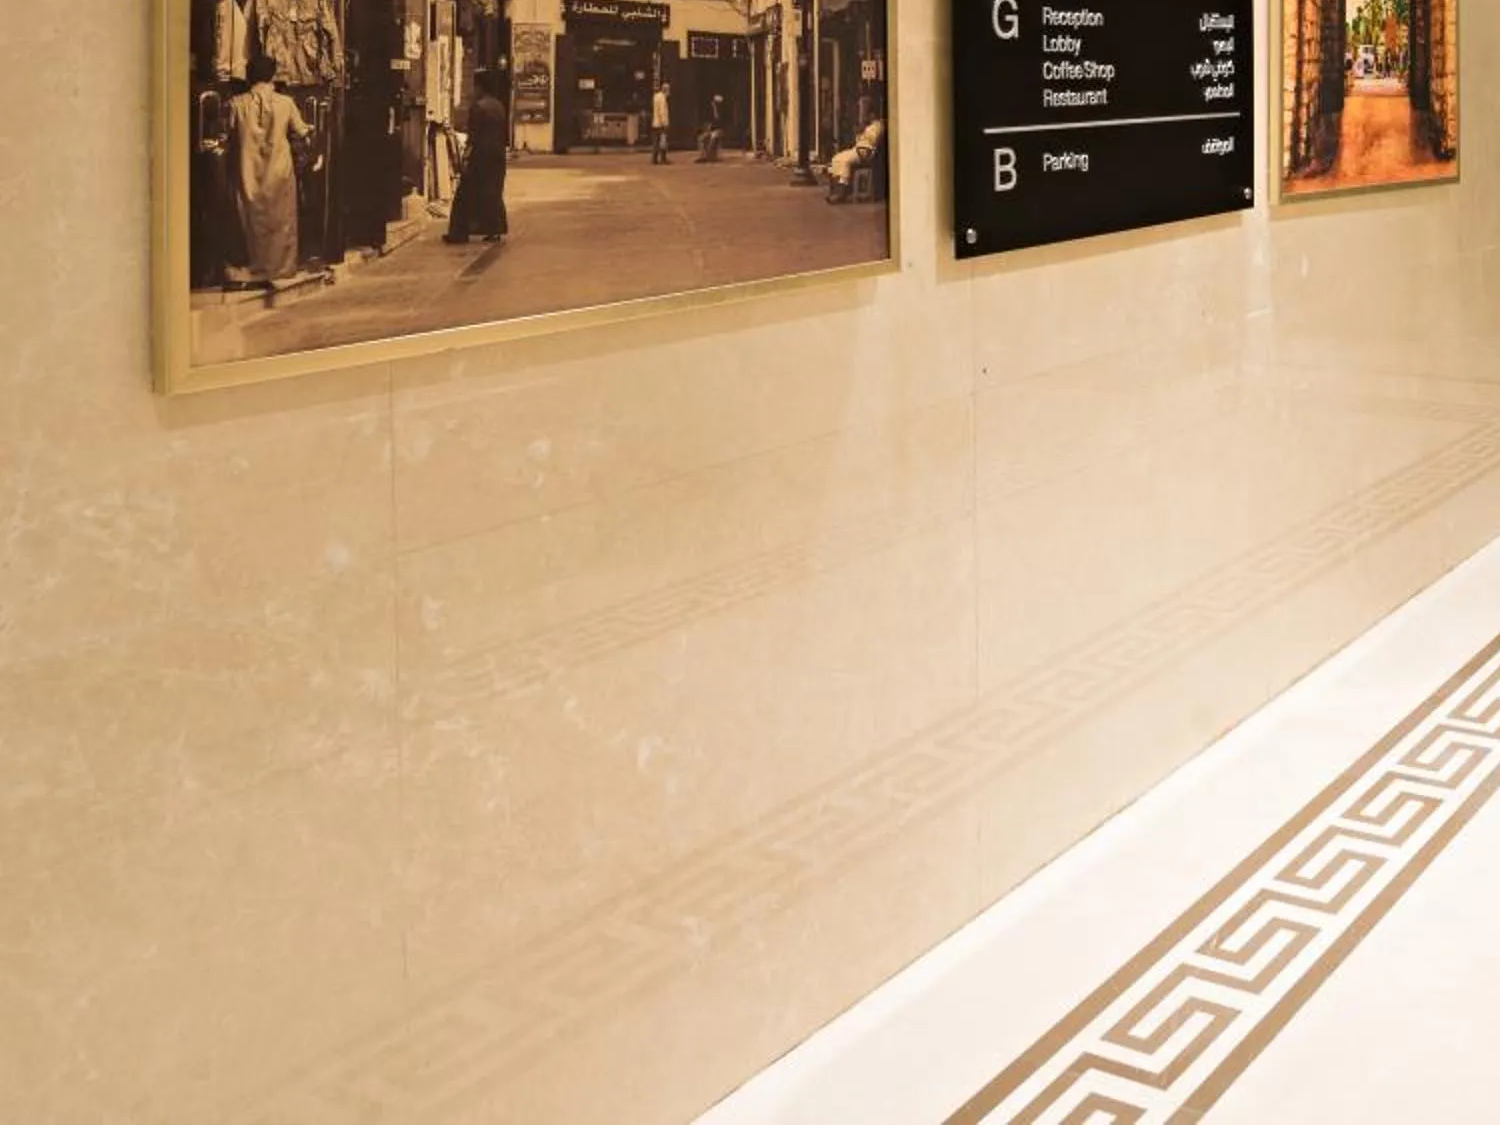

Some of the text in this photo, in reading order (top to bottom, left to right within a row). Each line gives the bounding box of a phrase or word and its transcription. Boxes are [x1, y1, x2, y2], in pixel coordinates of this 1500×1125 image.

[1043, 7, 1103, 29] Reception
[1044, 35, 1081, 56] Lobby
[1043, 61, 1115, 81] Coffee Shop
[1044, 89, 1107, 107] Restaurant
[994, 148, 1017, 191] B
[1044, 152, 1088, 171] Parking
